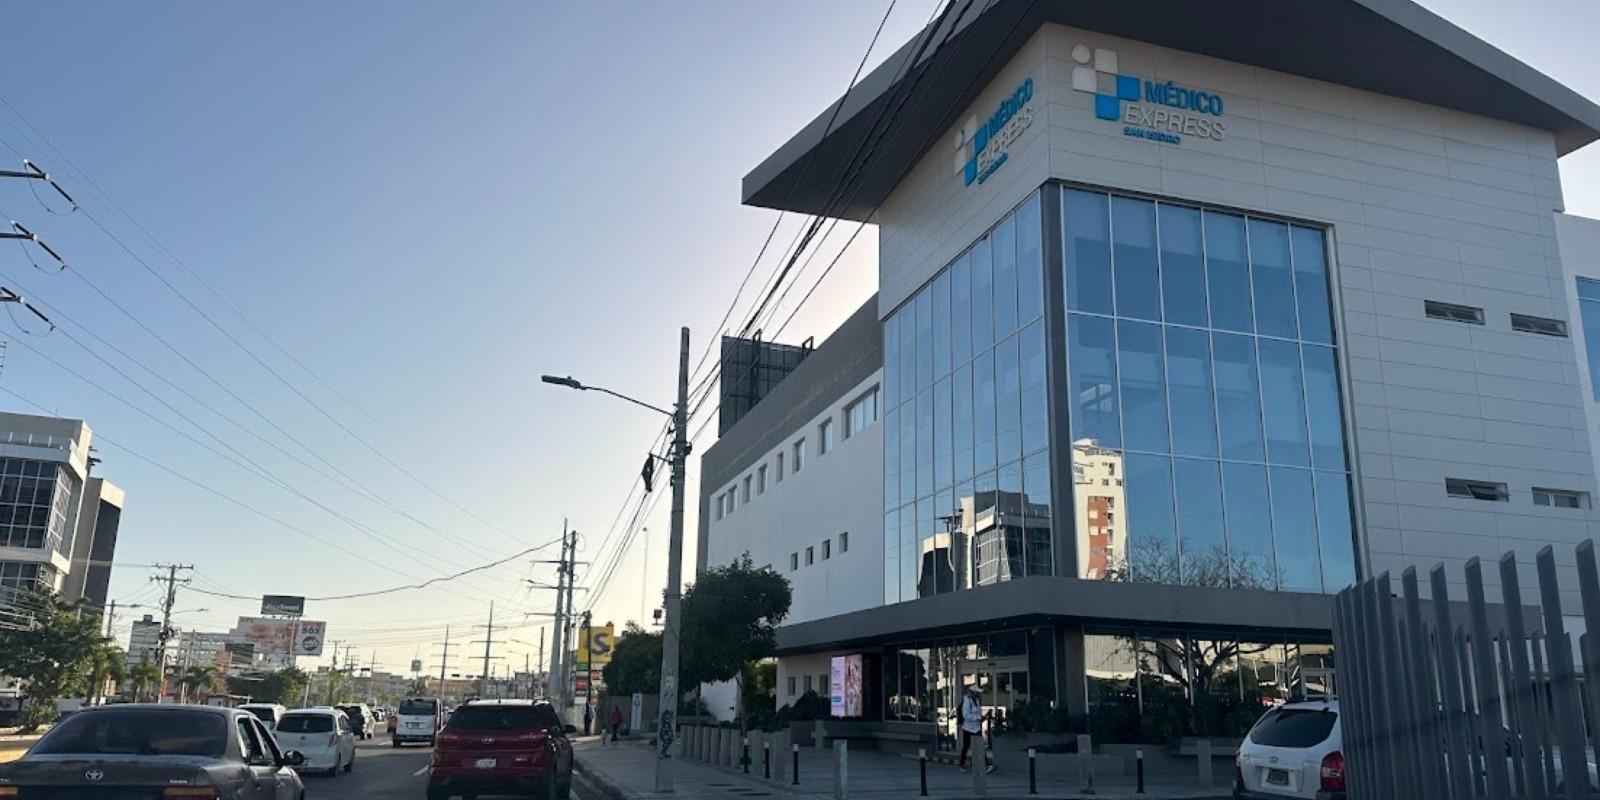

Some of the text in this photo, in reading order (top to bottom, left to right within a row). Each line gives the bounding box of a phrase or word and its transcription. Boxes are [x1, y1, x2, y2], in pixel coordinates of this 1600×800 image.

[981, 78, 1033, 138] MÉDICO
[1145, 80, 1223, 117] MÉDICO
[977, 104, 1033, 175] EXPRESS
[1123, 127, 1181, 145] SAN ISIDRO
[1124, 103, 1225, 142] EXPRESS
